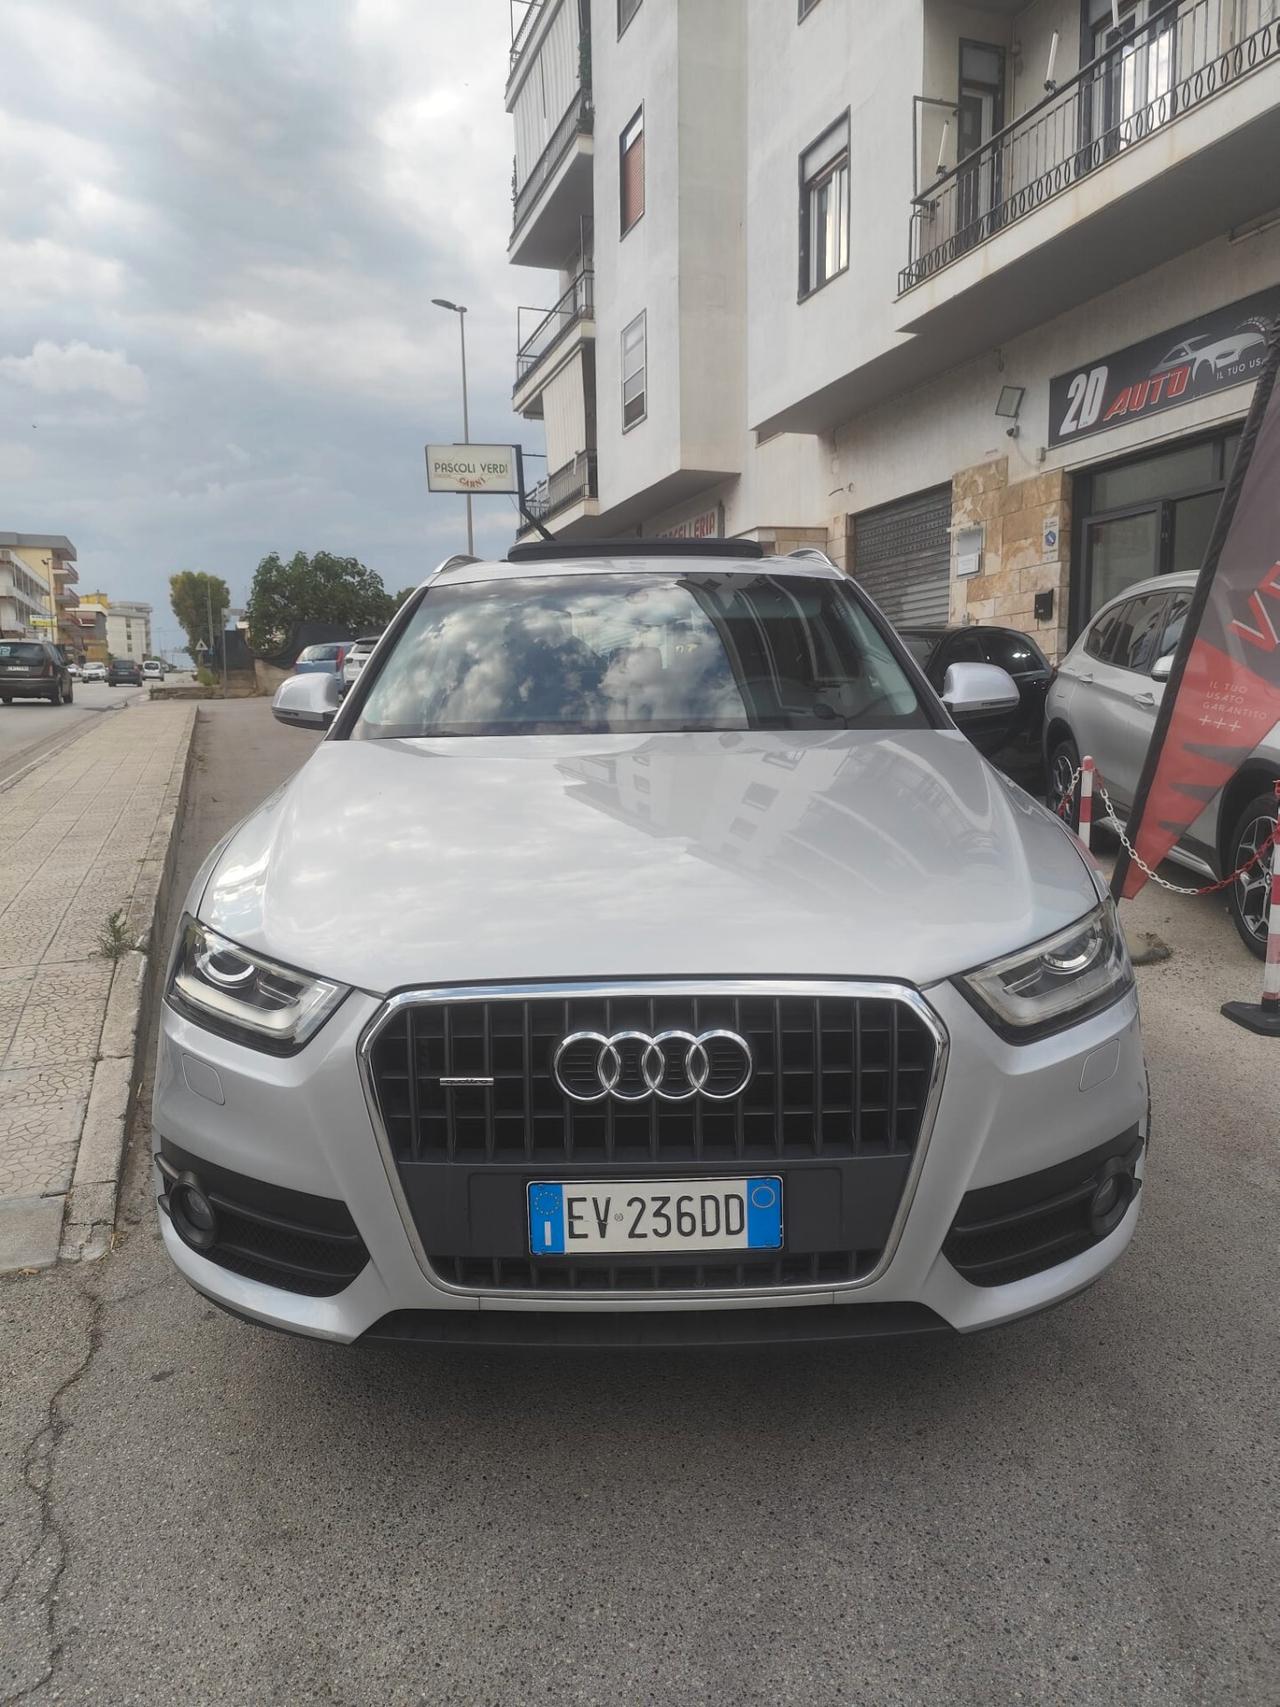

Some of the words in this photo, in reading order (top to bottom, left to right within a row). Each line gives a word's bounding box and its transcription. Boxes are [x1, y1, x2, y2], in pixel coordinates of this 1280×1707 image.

[1216, 370, 1225, 381] IL
[1227, 363, 1246, 377] TUO
[1058, 365, 1110, 437] 2D
[1103, 365, 1191, 422] AUTO
[434, 462, 476, 473] PASCOLI
[480, 463, 508, 474] VERDI
[1223, 682, 1248, 694] TUO
[1205, 691, 1244, 704] USATO
[1202, 701, 1268, 720] GARANTITO
